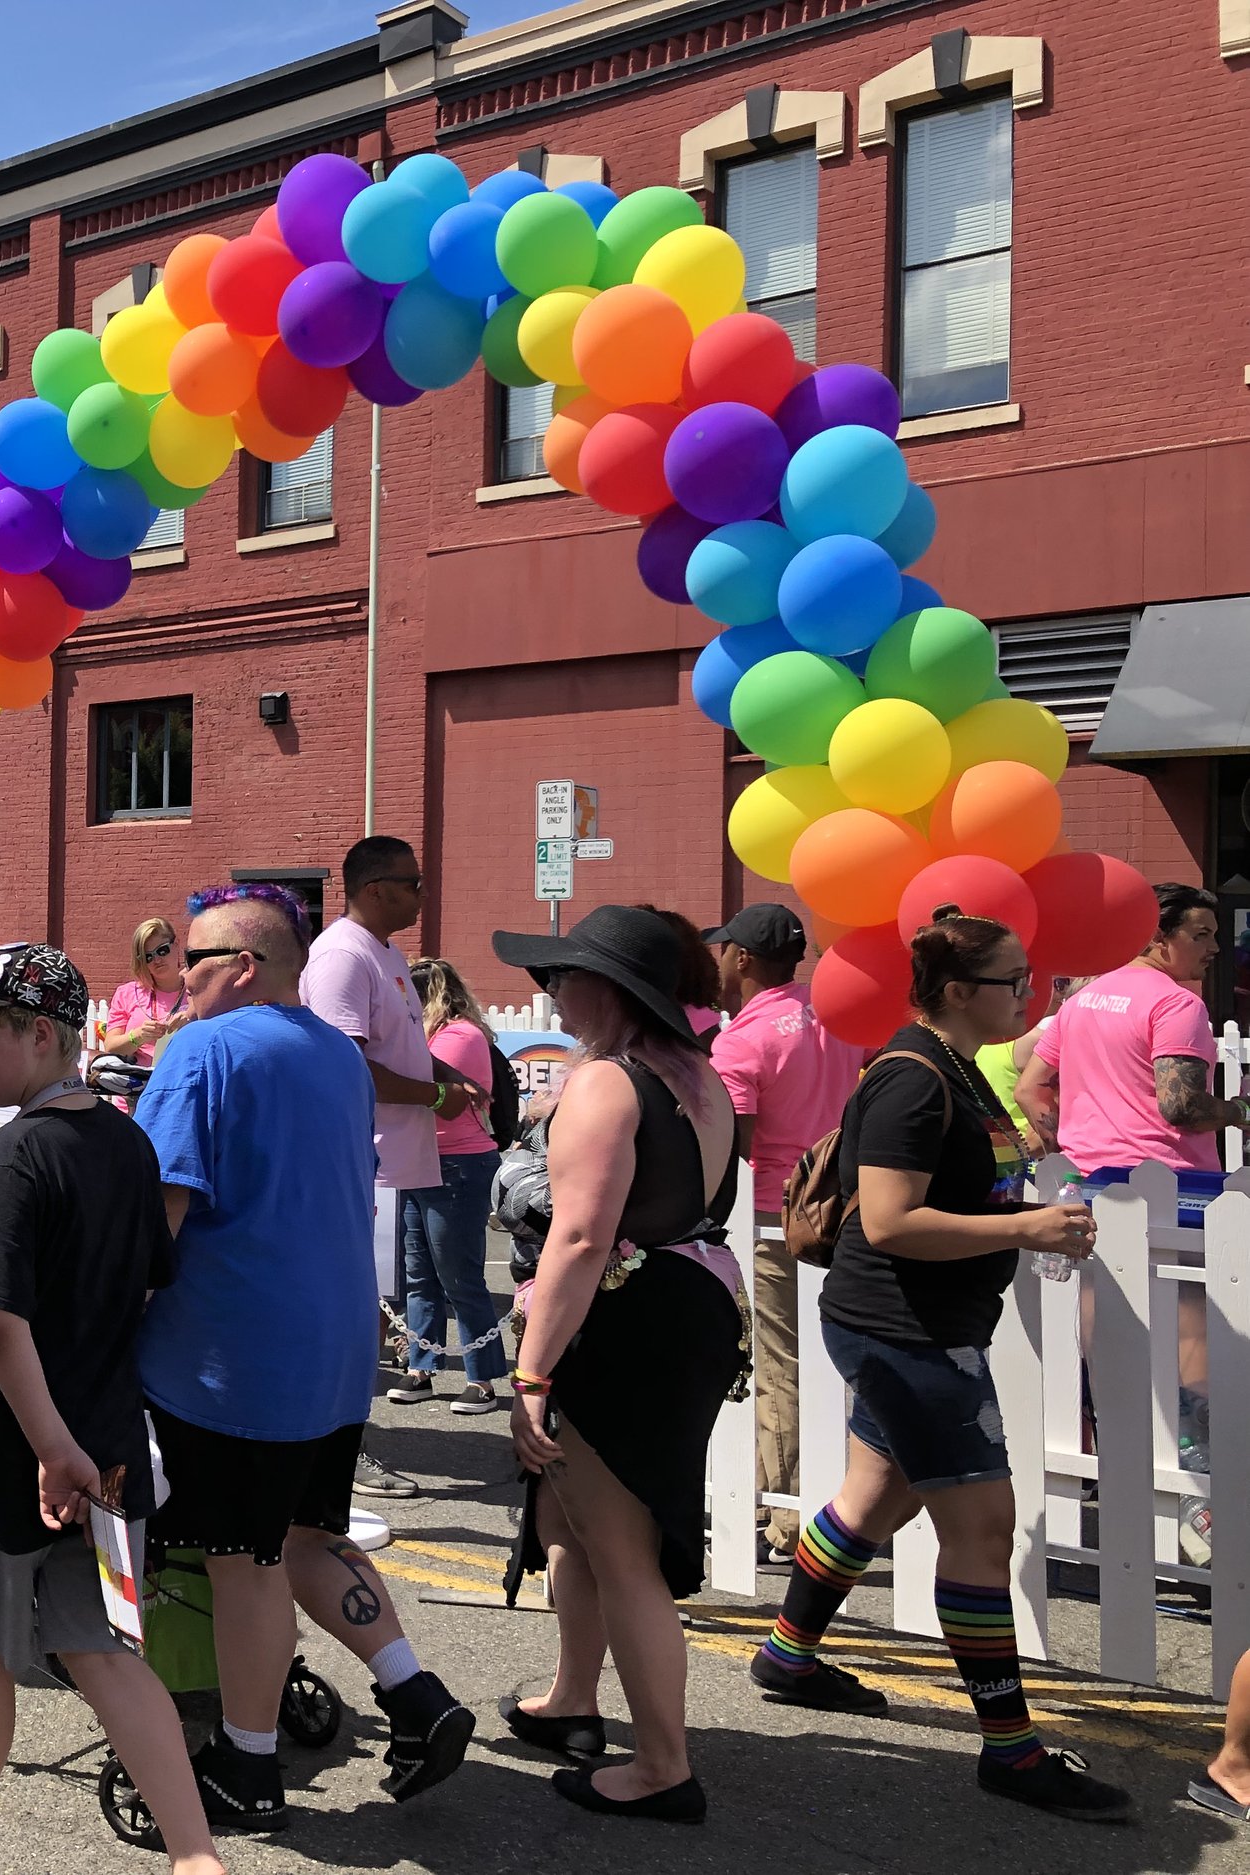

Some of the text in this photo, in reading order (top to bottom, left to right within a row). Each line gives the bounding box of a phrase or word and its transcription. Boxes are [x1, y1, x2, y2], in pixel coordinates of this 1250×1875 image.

[542, 786, 568, 795] BACK-IN
[545, 796, 565, 804] ANGLE
[542, 806, 568, 814] PARKING
[547, 816, 562, 824] ONLY
[538, 845, 547, 860] 2
[1078, 992, 1131, 1014] VOLUNTEER
[965, 1679, 1017, 1693] Pride
